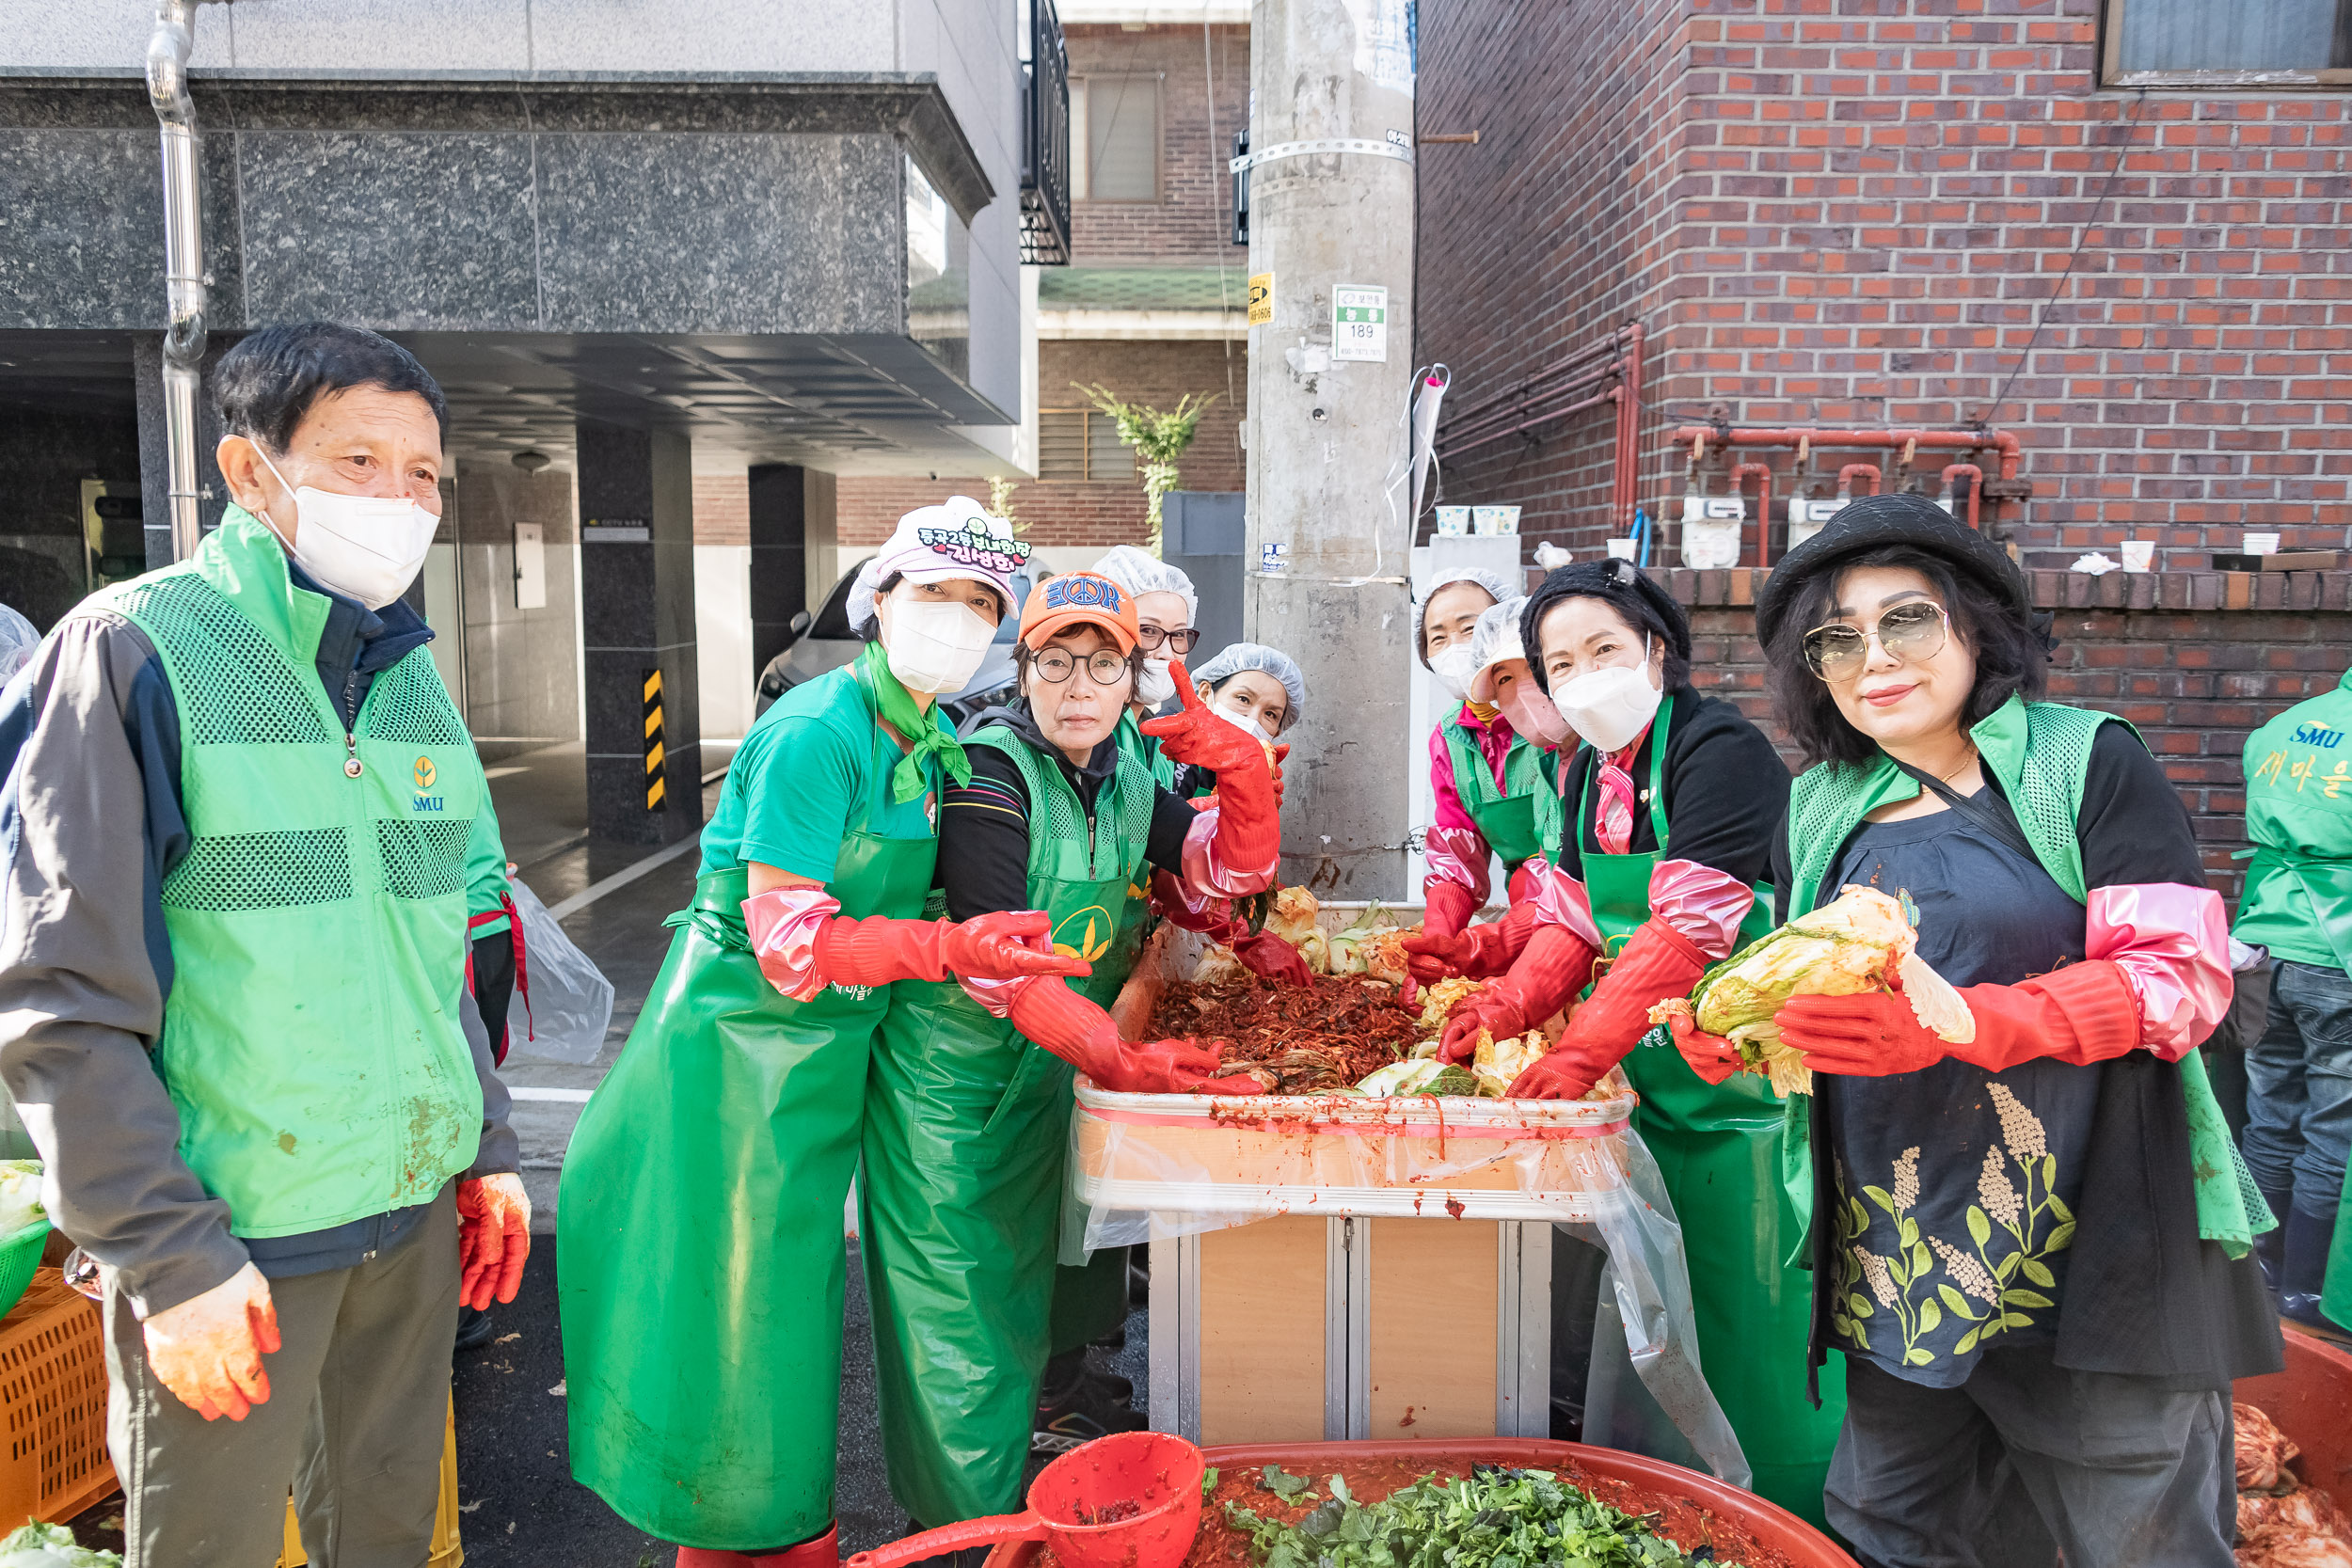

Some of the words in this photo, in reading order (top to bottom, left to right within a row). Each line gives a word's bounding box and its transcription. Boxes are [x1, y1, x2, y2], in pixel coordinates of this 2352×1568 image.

[1351, 325, 1374, 339] 189
[2289, 724, 2345, 749] SMU
[2254, 750, 2352, 799] 새마을
[412, 795, 444, 812] SMU
